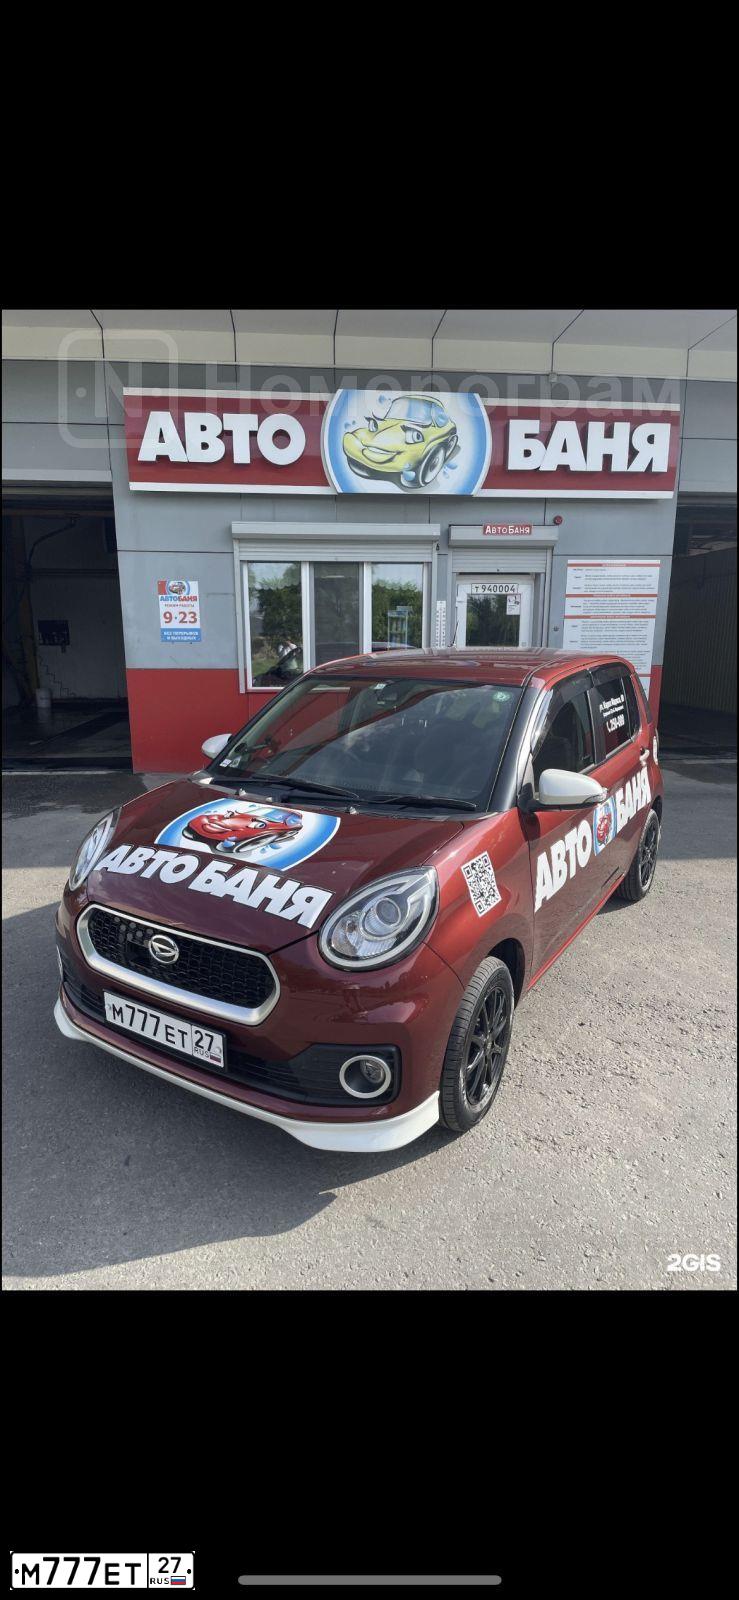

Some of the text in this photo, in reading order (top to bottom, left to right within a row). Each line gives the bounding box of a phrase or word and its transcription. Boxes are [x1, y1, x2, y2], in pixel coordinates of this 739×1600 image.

[137, 411, 672, 474] АВТО БАНЯ
[534, 765, 652, 913] АВТО БАНЯ
[94, 844, 334, 929] АВТО БАНЯ
[194, 1030, 214, 1052] 27
[194, 1047, 210, 1058] RUS
